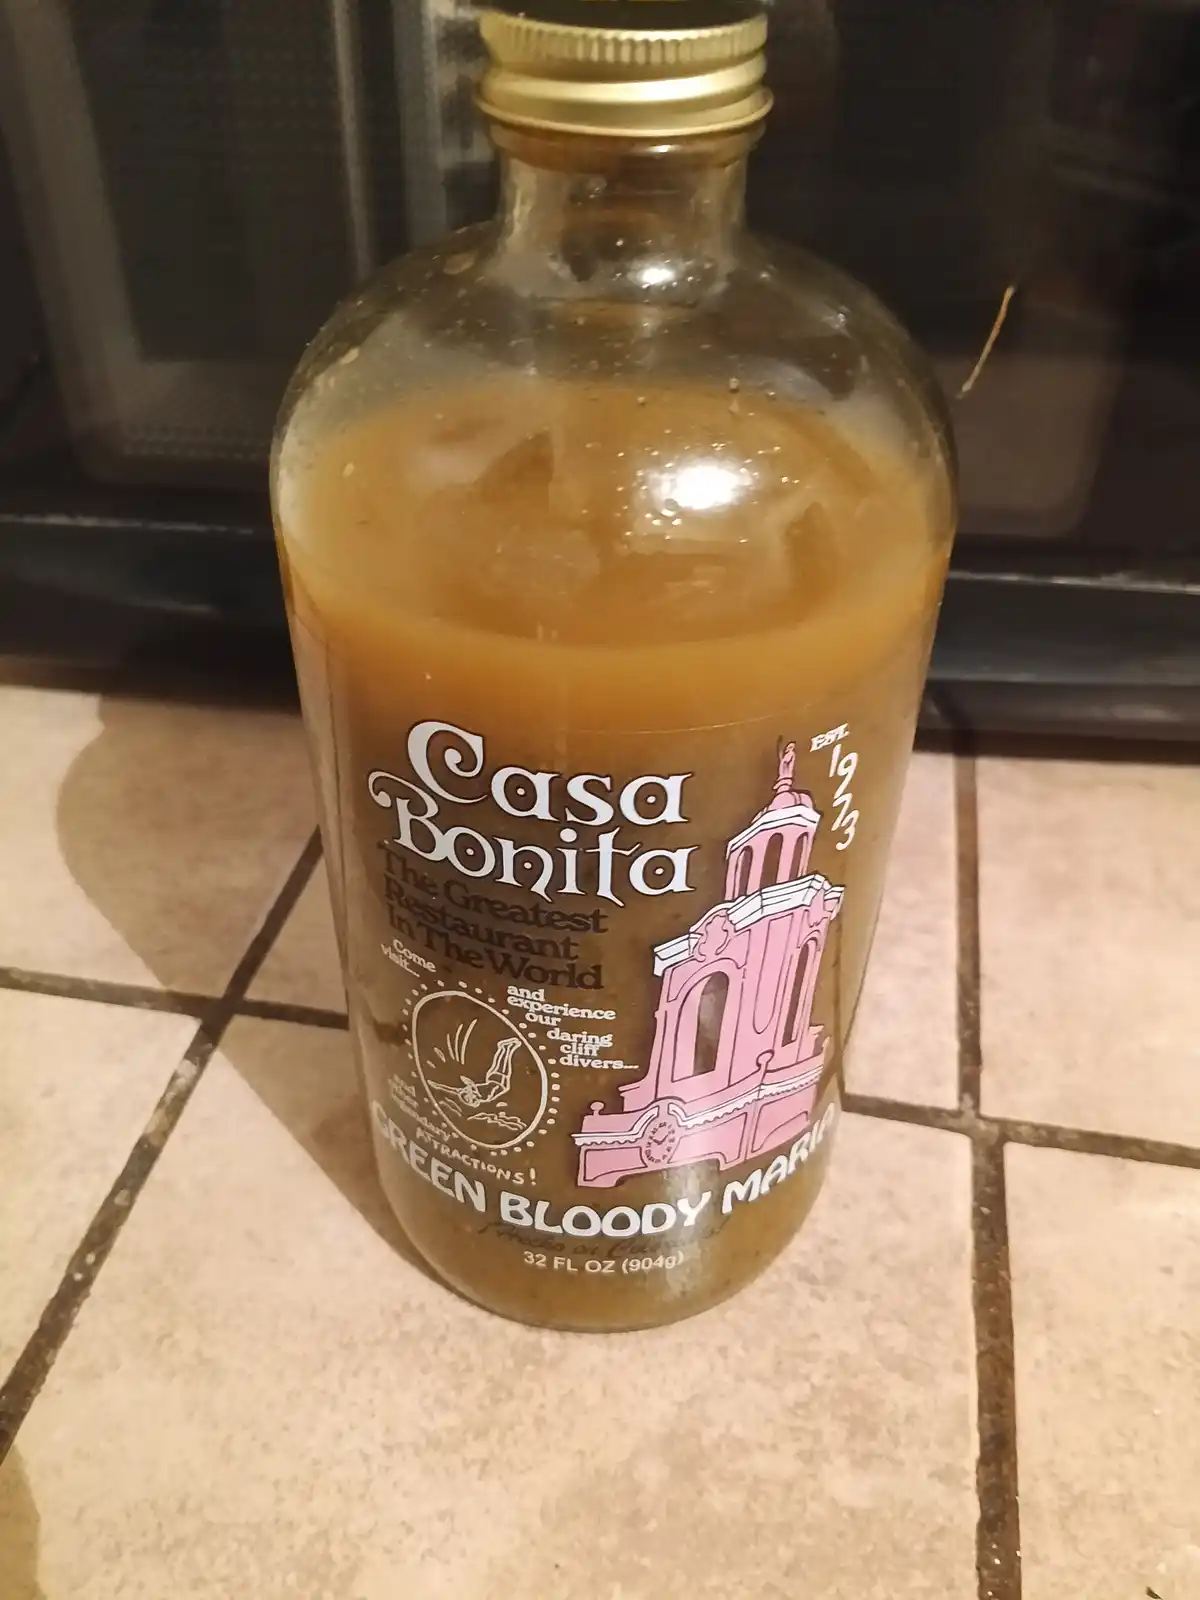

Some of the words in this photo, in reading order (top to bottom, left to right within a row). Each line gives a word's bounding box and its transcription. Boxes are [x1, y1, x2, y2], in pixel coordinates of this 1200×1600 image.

[407, 720, 692, 826] Casa
[828, 743, 860, 851] 1973
[368, 770, 699, 908] Bonita
[384, 848, 438, 896] The
[443, 879, 609, 934] Greatest
[384, 872, 579, 960] Restaurant
[393, 938, 437, 973] Come
[416, 920, 483, 969] The
[483, 949, 604, 991] World
[507, 985, 546, 1002] and
[507, 995, 617, 1021] experience
[525, 1011, 562, 1026] our
[547, 1027, 613, 1048] daring
[560, 1041, 600, 1058] cliff
[369, 1100, 486, 1213] GREEN
[499, 1190, 712, 1237] BLOODY
[721, 1102, 835, 1214] MARIA
[523, 1250, 547, 1268] 32
[553, 1256, 578, 1272] FL
[585, 1259, 616, 1273] OZ
[621, 1251, 685, 1274] (904g)
